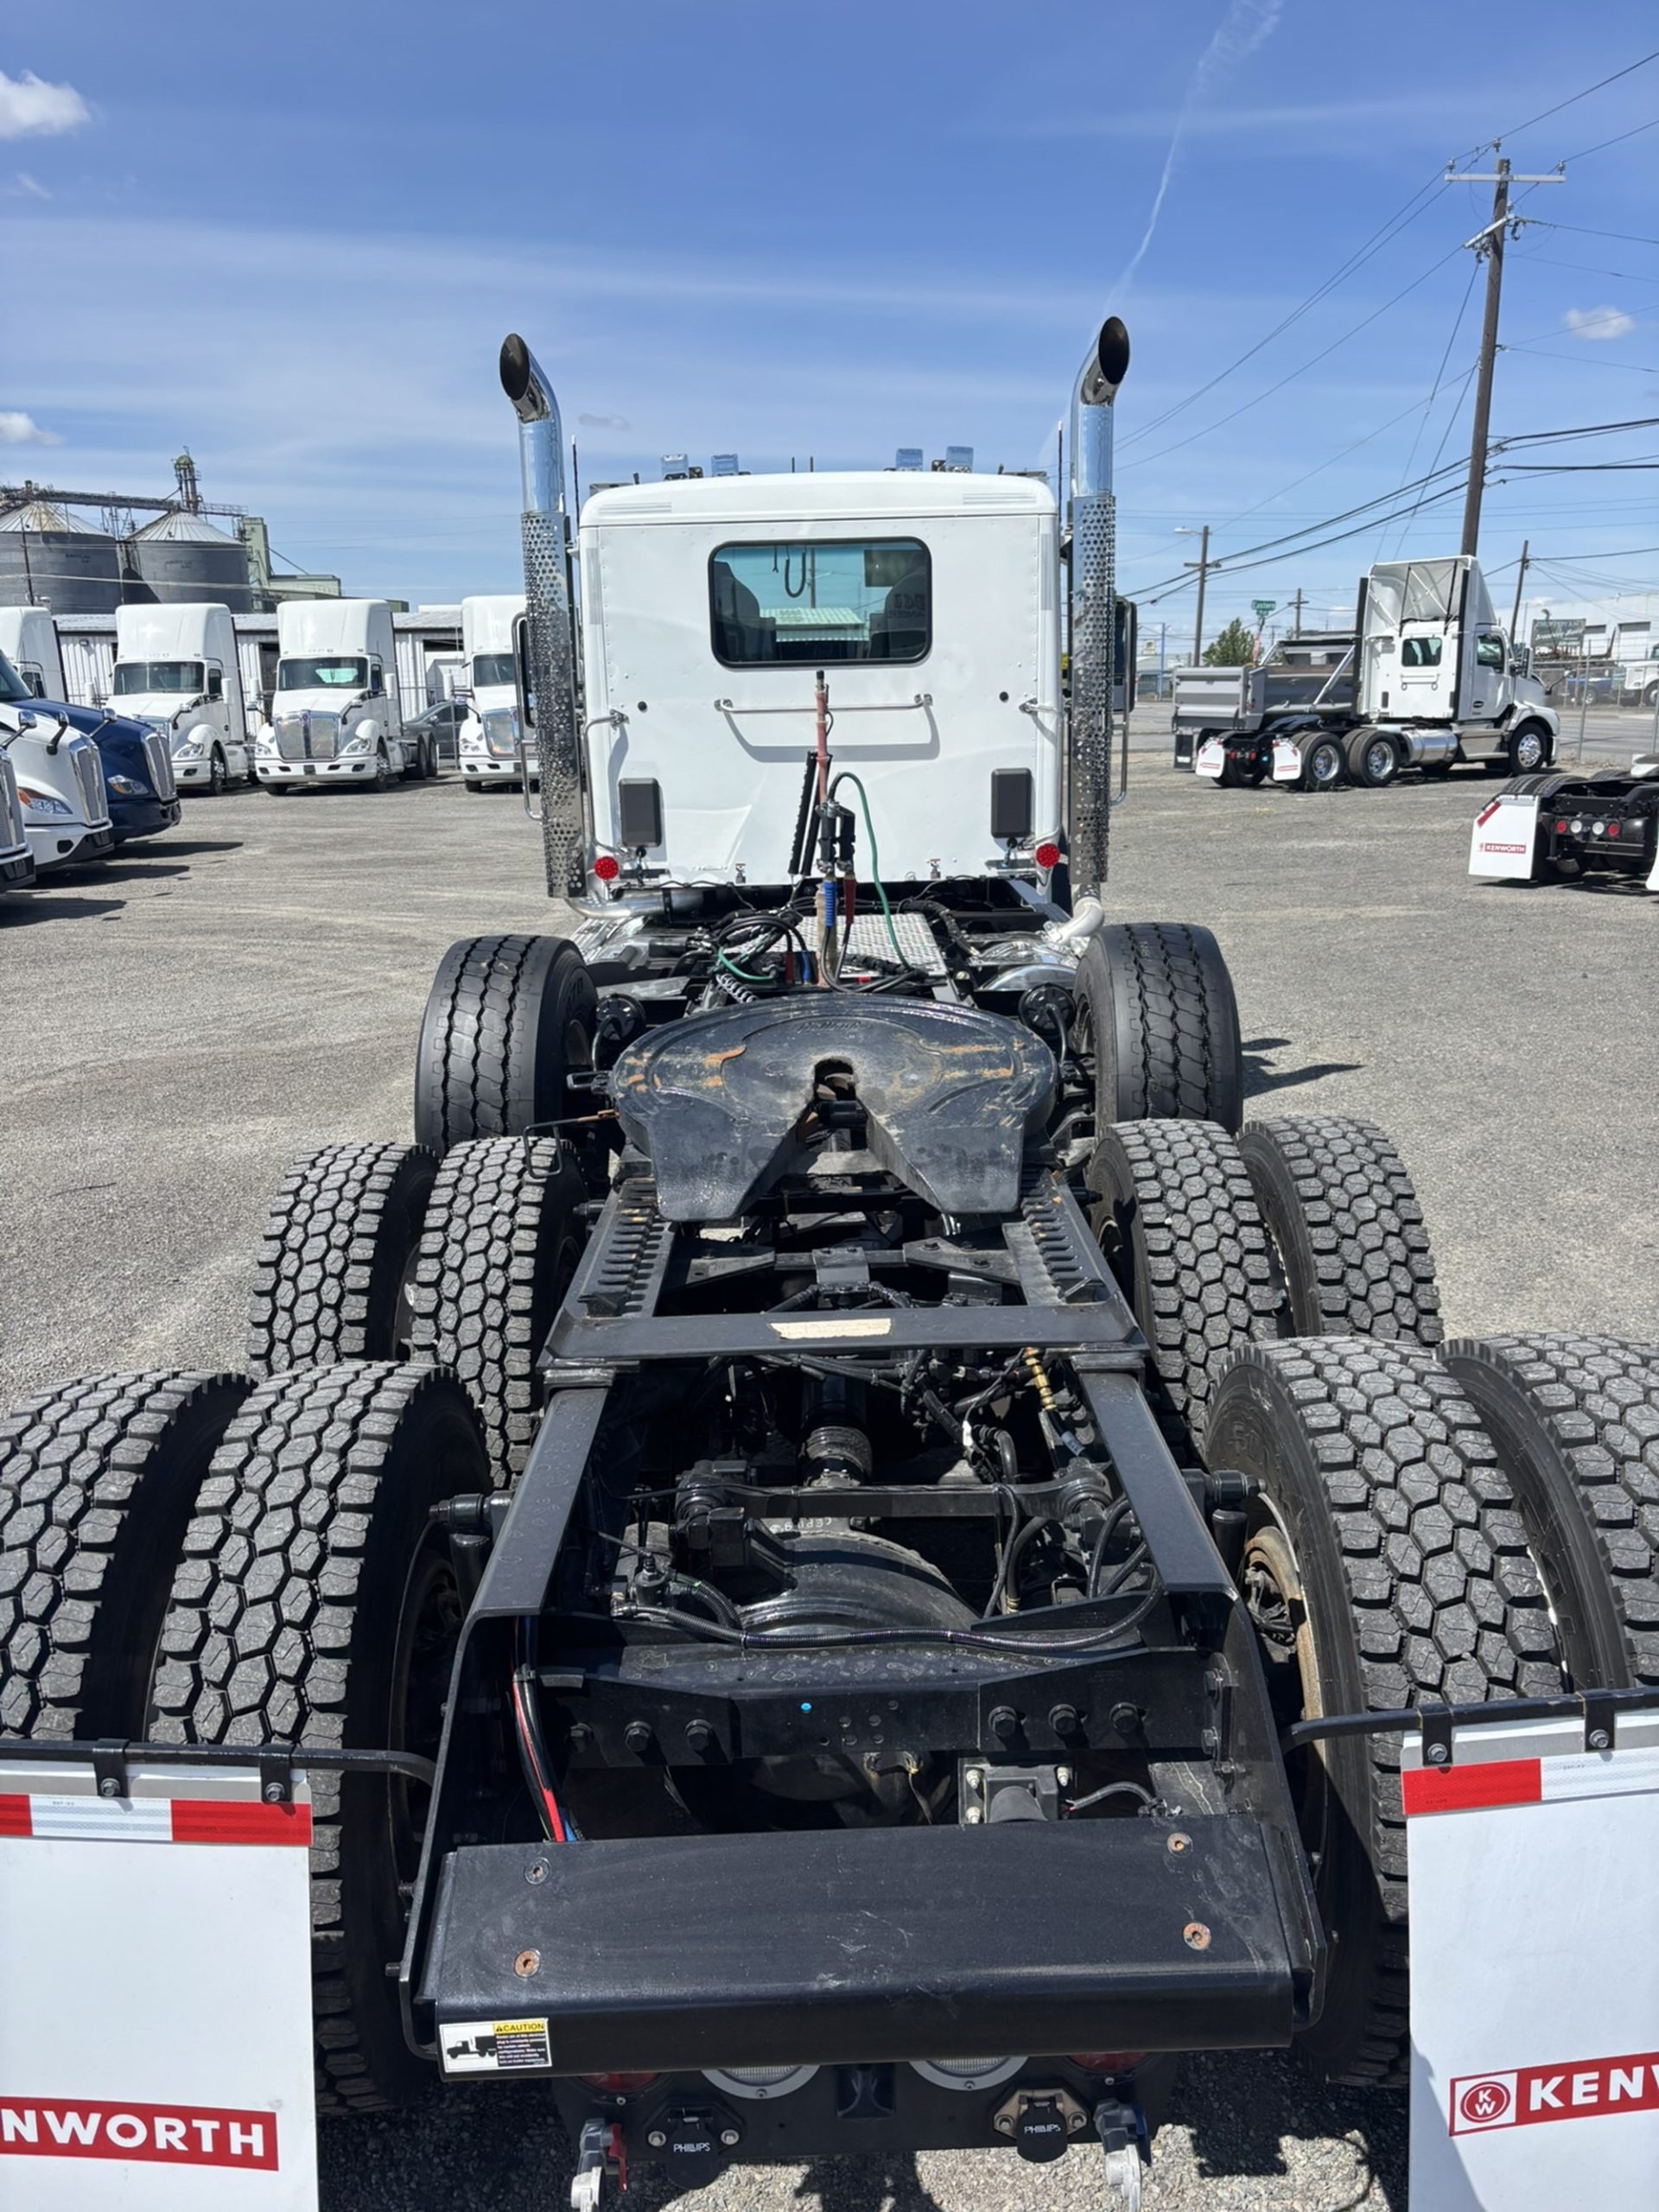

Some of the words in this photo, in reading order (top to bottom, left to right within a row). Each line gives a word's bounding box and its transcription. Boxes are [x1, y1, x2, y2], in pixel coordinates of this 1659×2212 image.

[503, 2023, 544, 2031] CAUTION
[1529, 2064, 1659, 2111] KEN
[1, 2108, 264, 2157] NWORTH
[1024, 2124, 1061, 2133] PHILLIPS
[673, 2143, 710, 2152] PHILLIPS
